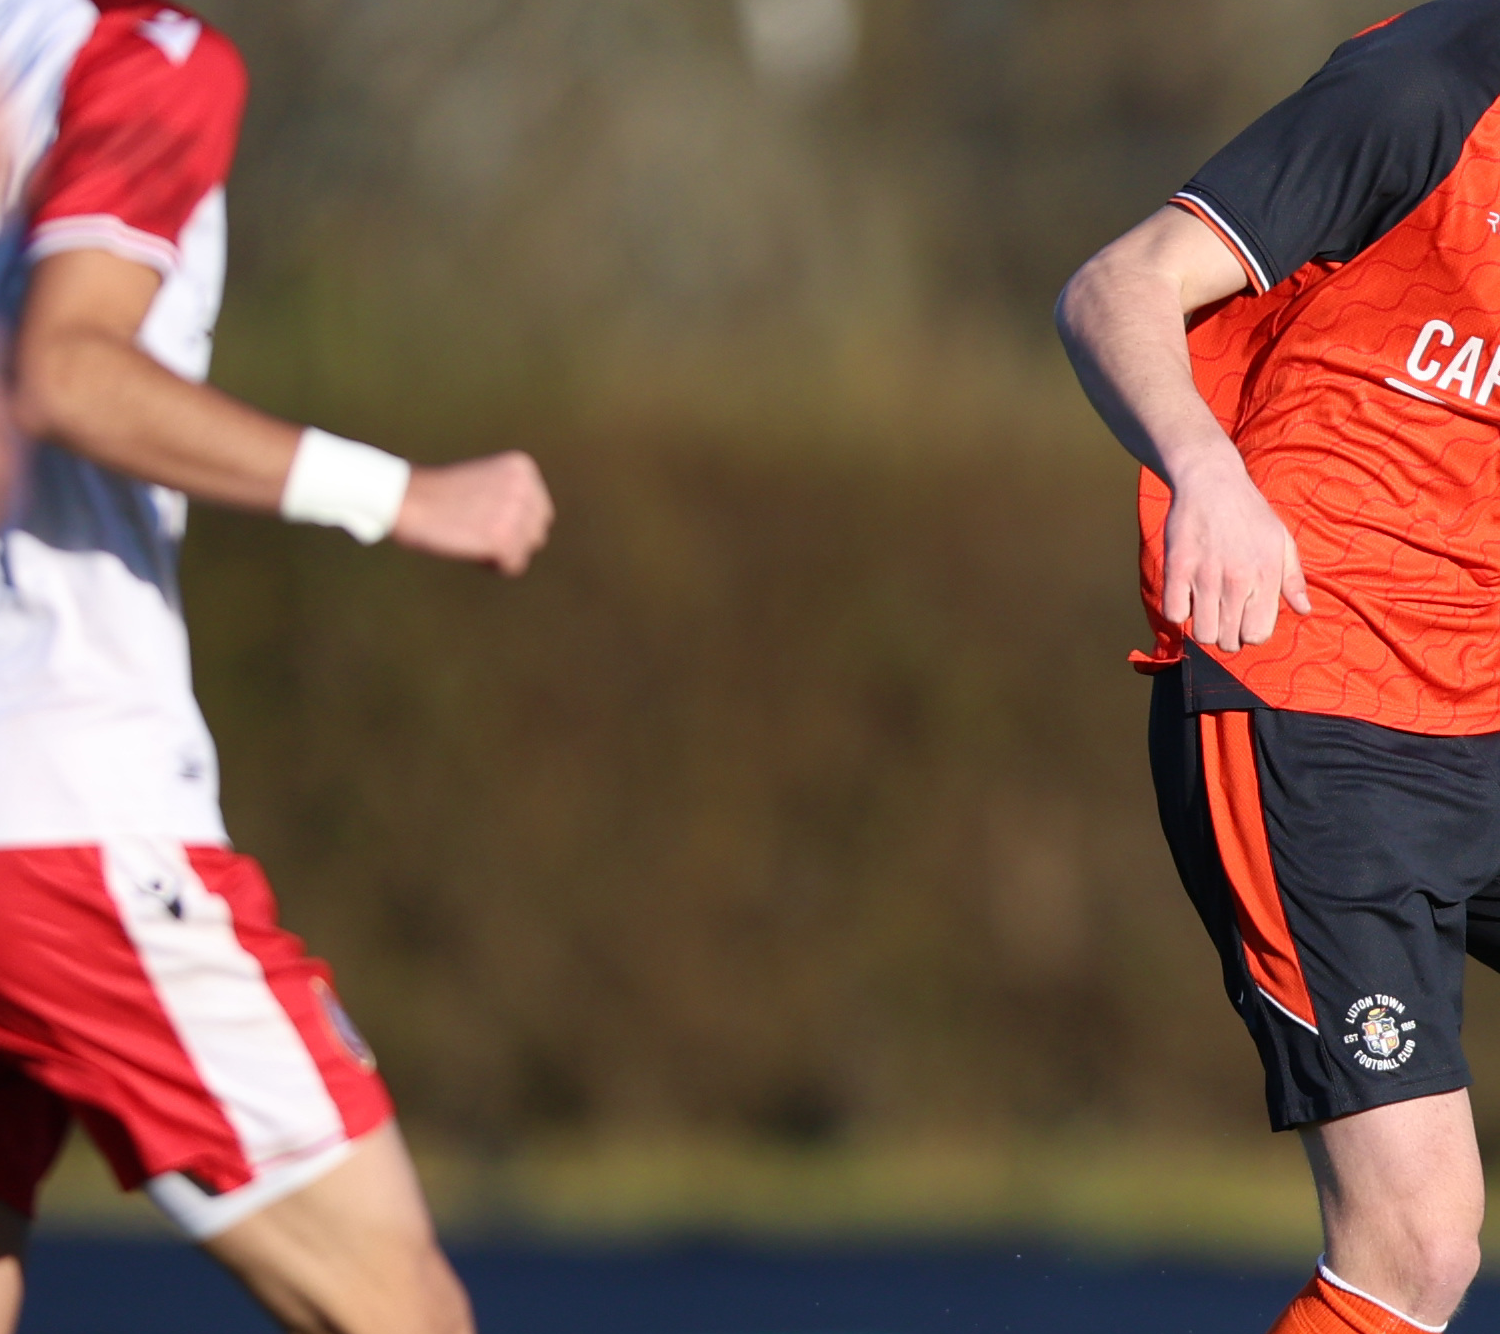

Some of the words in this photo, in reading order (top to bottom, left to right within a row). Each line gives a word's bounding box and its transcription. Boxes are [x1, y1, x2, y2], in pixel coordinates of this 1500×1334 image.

[1345, 996, 1374, 1024] LUTON
[1375, 994, 1406, 1014] TOWN
[1344, 1033, 1359, 1044] EST
[1353, 1050, 1400, 1070] FOOTBALL
